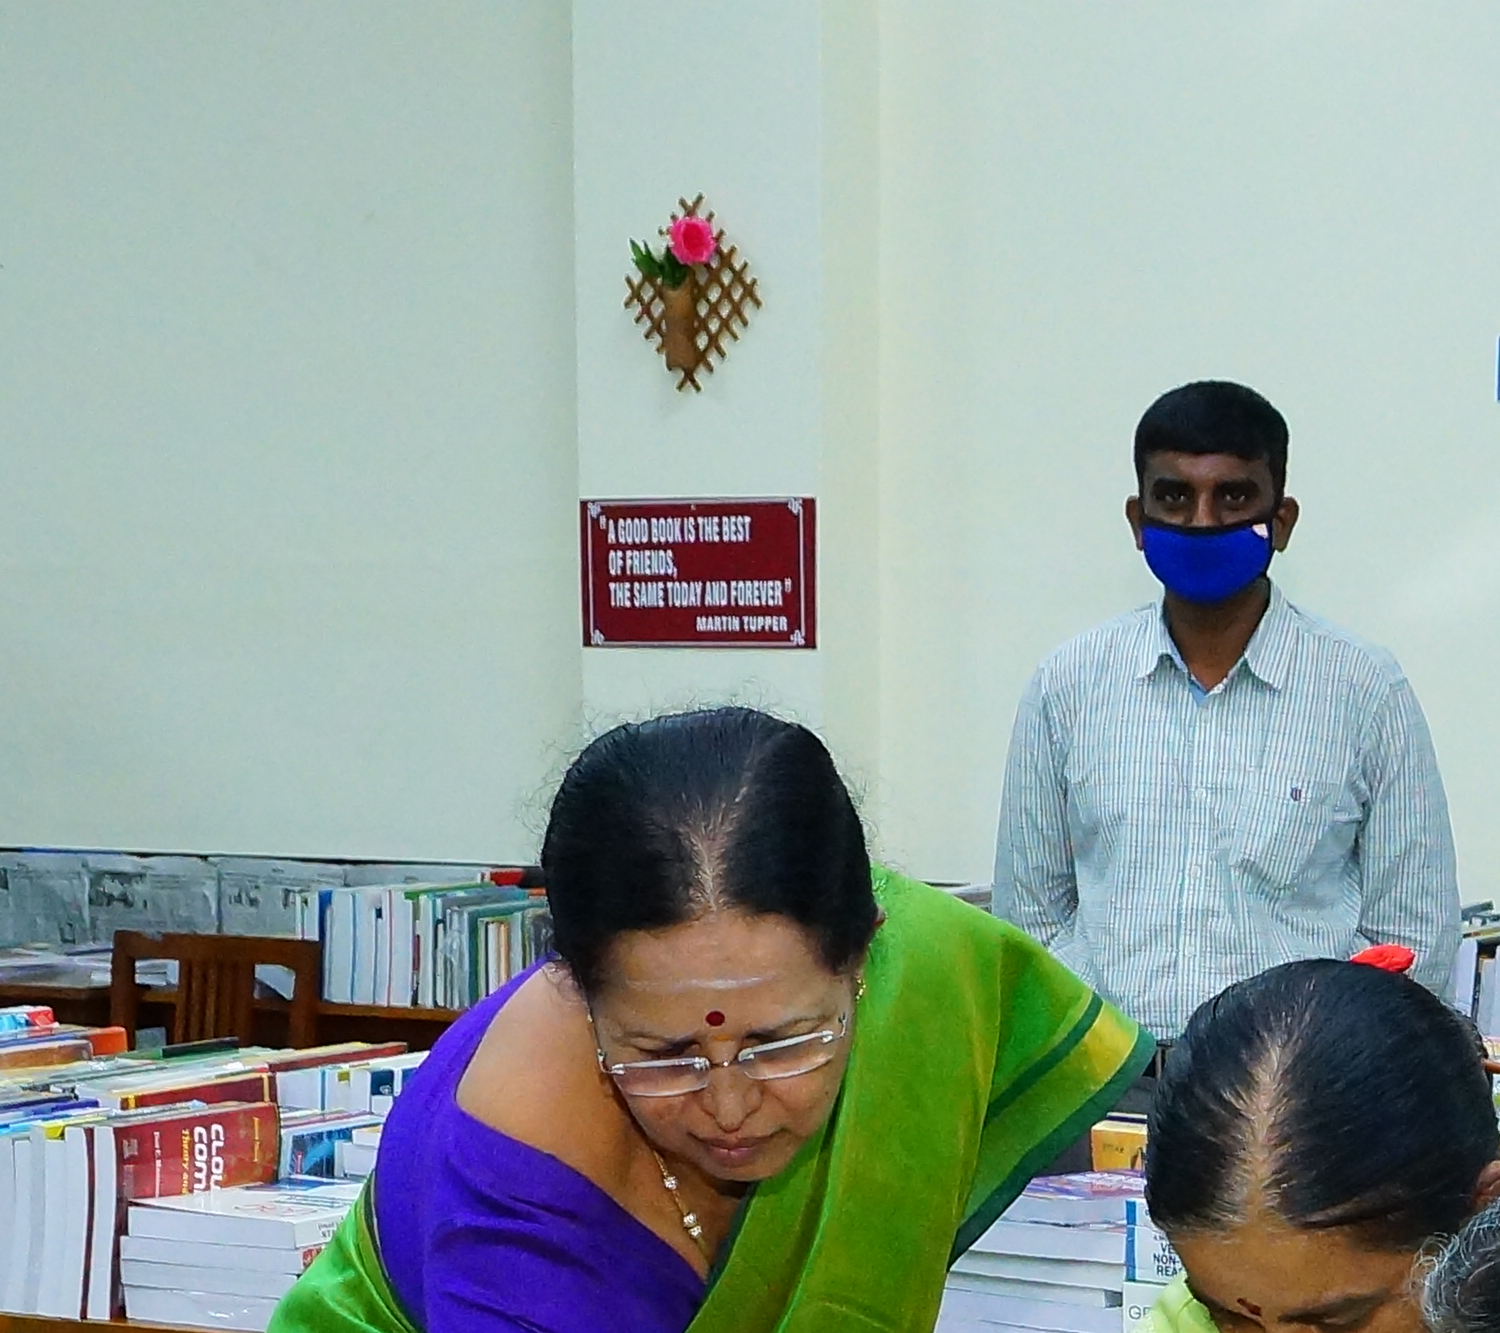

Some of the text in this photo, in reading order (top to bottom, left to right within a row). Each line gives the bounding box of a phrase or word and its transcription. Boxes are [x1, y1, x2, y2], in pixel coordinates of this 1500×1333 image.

[618, 518, 648, 544] GOOD
[651, 518, 682, 543] BOOK
[684, 517, 695, 542] IS
[698, 516, 719, 542] THE
[723, 515, 751, 542] BEST
[609, 550, 678, 579] OF FRIENDS,
[609, 582, 631, 607] THE
[633, 581, 664, 607] SAME
[667, 581, 702, 607] TODAY
[704, 581, 727, 606] AND
[696, 616, 788, 632] MARTIN TUPPER
